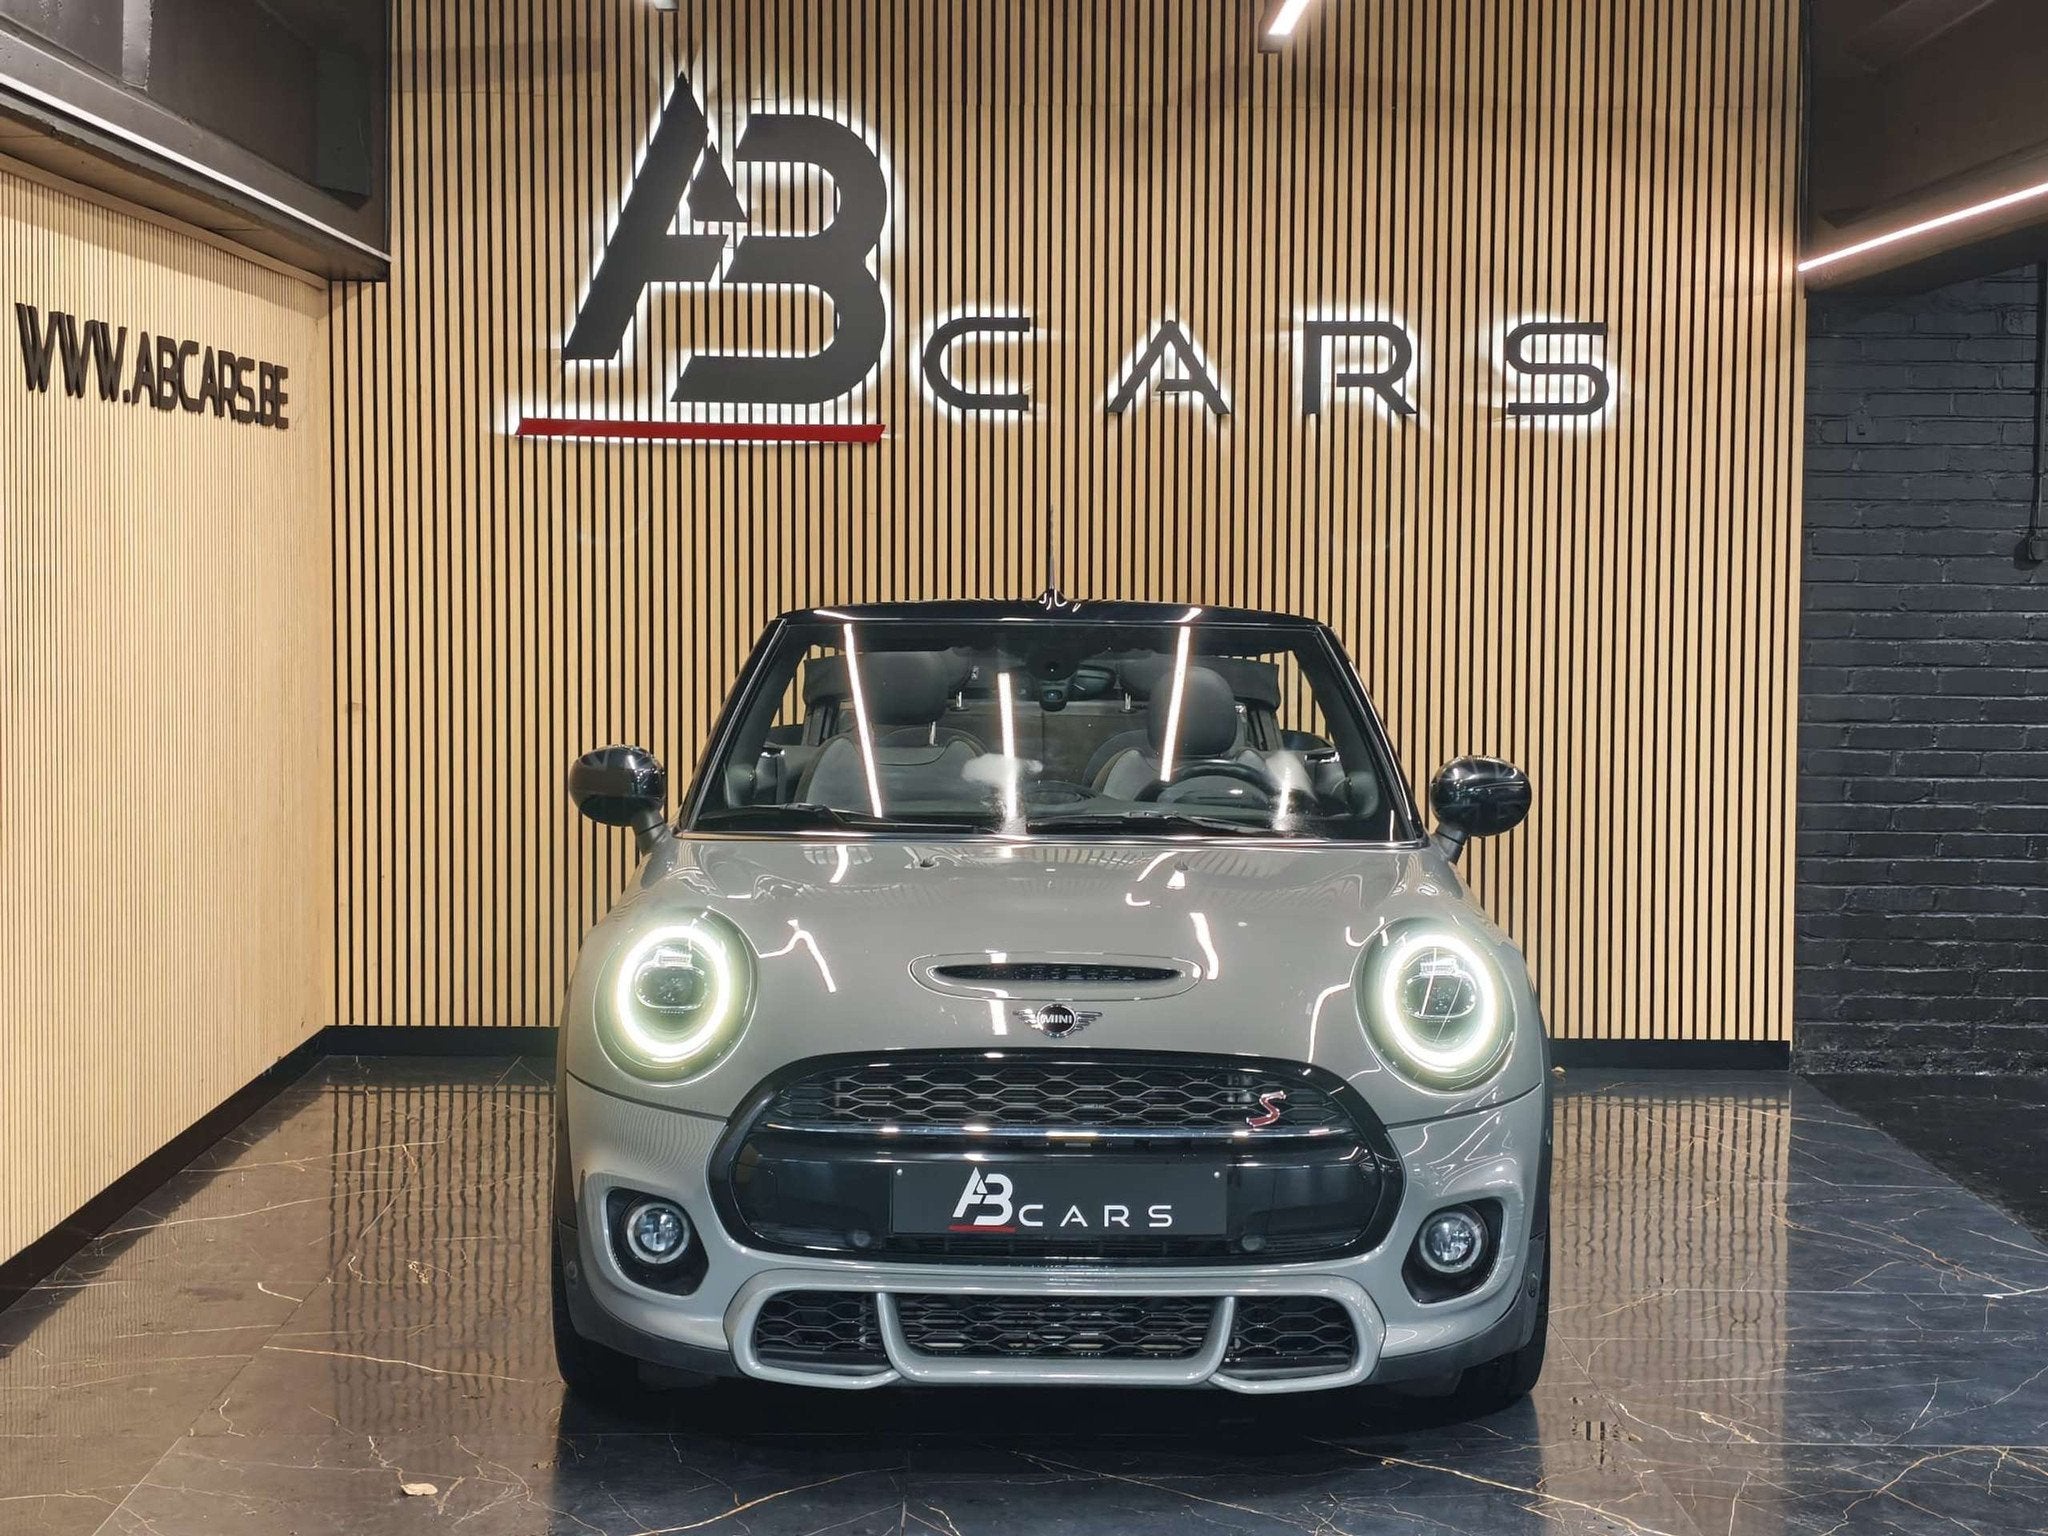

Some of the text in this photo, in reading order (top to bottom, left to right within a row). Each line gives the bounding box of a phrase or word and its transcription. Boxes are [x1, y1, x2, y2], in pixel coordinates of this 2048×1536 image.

[14, 302, 289, 430] WWW.ABCARS.BE
[922, 316, 1610, 415] CARS
[1041, 1014, 1072, 1024] MINI
[1018, 1204, 1173, 1228] CARS
